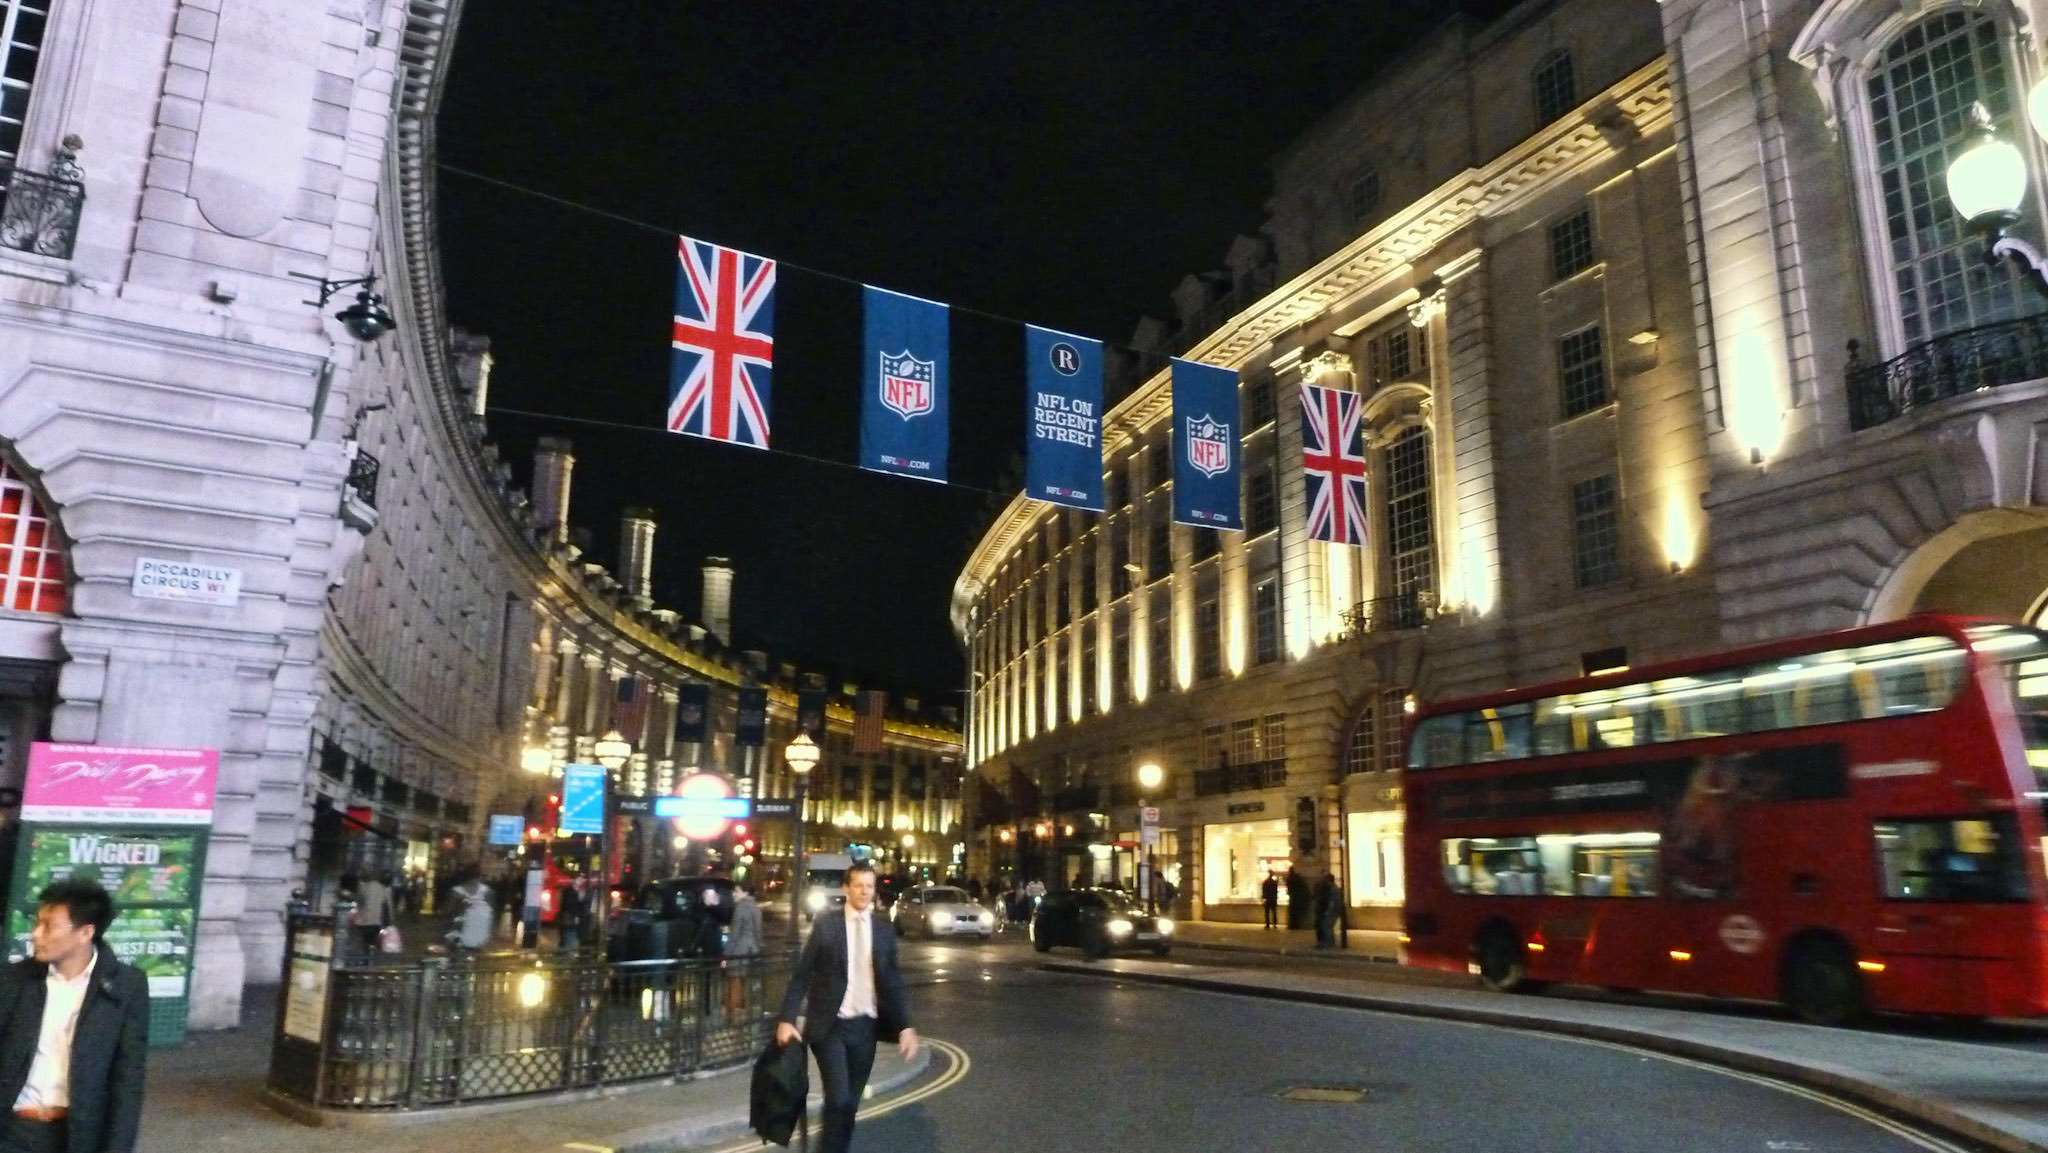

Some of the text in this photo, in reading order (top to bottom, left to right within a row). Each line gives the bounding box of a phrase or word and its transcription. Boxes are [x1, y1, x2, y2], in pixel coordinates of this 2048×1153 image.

[1058, 350, 1076, 371] R
[887, 377, 928, 410] NFL
[1037, 392, 1093, 416] NFL ON
[1034, 406, 1097, 433] REGENT
[1035, 423, 1096, 448] STREET
[1193, 439, 1225, 468] NFL
[141, 574, 200, 590] CIRCUS
[143, 562, 232, 581] PICCADILLY
[756, 803, 791, 813] SUBWAY
